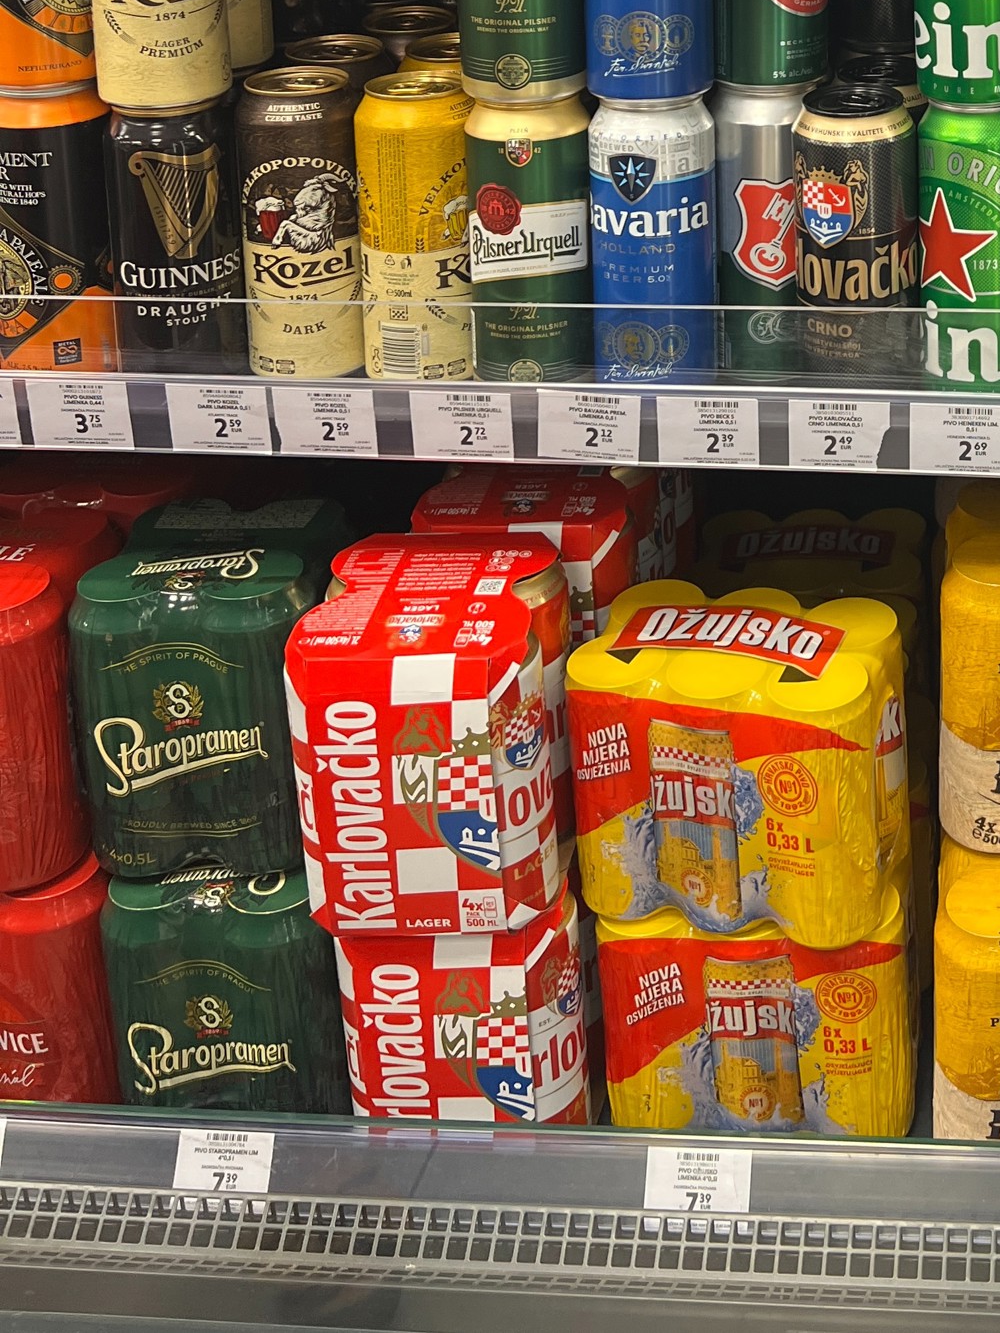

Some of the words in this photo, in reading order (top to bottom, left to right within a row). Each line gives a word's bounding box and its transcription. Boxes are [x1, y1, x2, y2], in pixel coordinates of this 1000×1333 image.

[155, 11, 186, 21] 1874
[139, 38, 204, 58] PREMIUM
[155, 37, 190, 47] LAGER
[267, 102, 320, 112] AUTHENTIC
[120, 247, 240, 289] GUINNESS
[253, 246, 354, 286] Kozel
[137, 292, 231, 317] DRAUGHT
[167, 313, 207, 327] STOUT
[283, 321, 327, 334] DARK
[807, 318, 852, 337] CRNO
[75, 414, 89, 433] 3
[215, 418, 228, 438] 2
[229, 419, 241, 428] 59
[636, 608, 823, 660] Ožujsko
[587, 722, 628, 747] NOVA
[93, 717, 270, 797] Staropramen
[582, 740, 630, 766] MJERA
[577, 760, 631, 780] OSVJEŽENJA
[313, 700, 397, 930] Karlovačko
[406, 918, 451, 927] LAGER
[639, 963, 681, 988] NOVA
[634, 979, 683, 1007] MJERA
[626, 993, 685, 1025] OSVJEŽENJA
[128, 1022, 296, 1095] Staropramen
